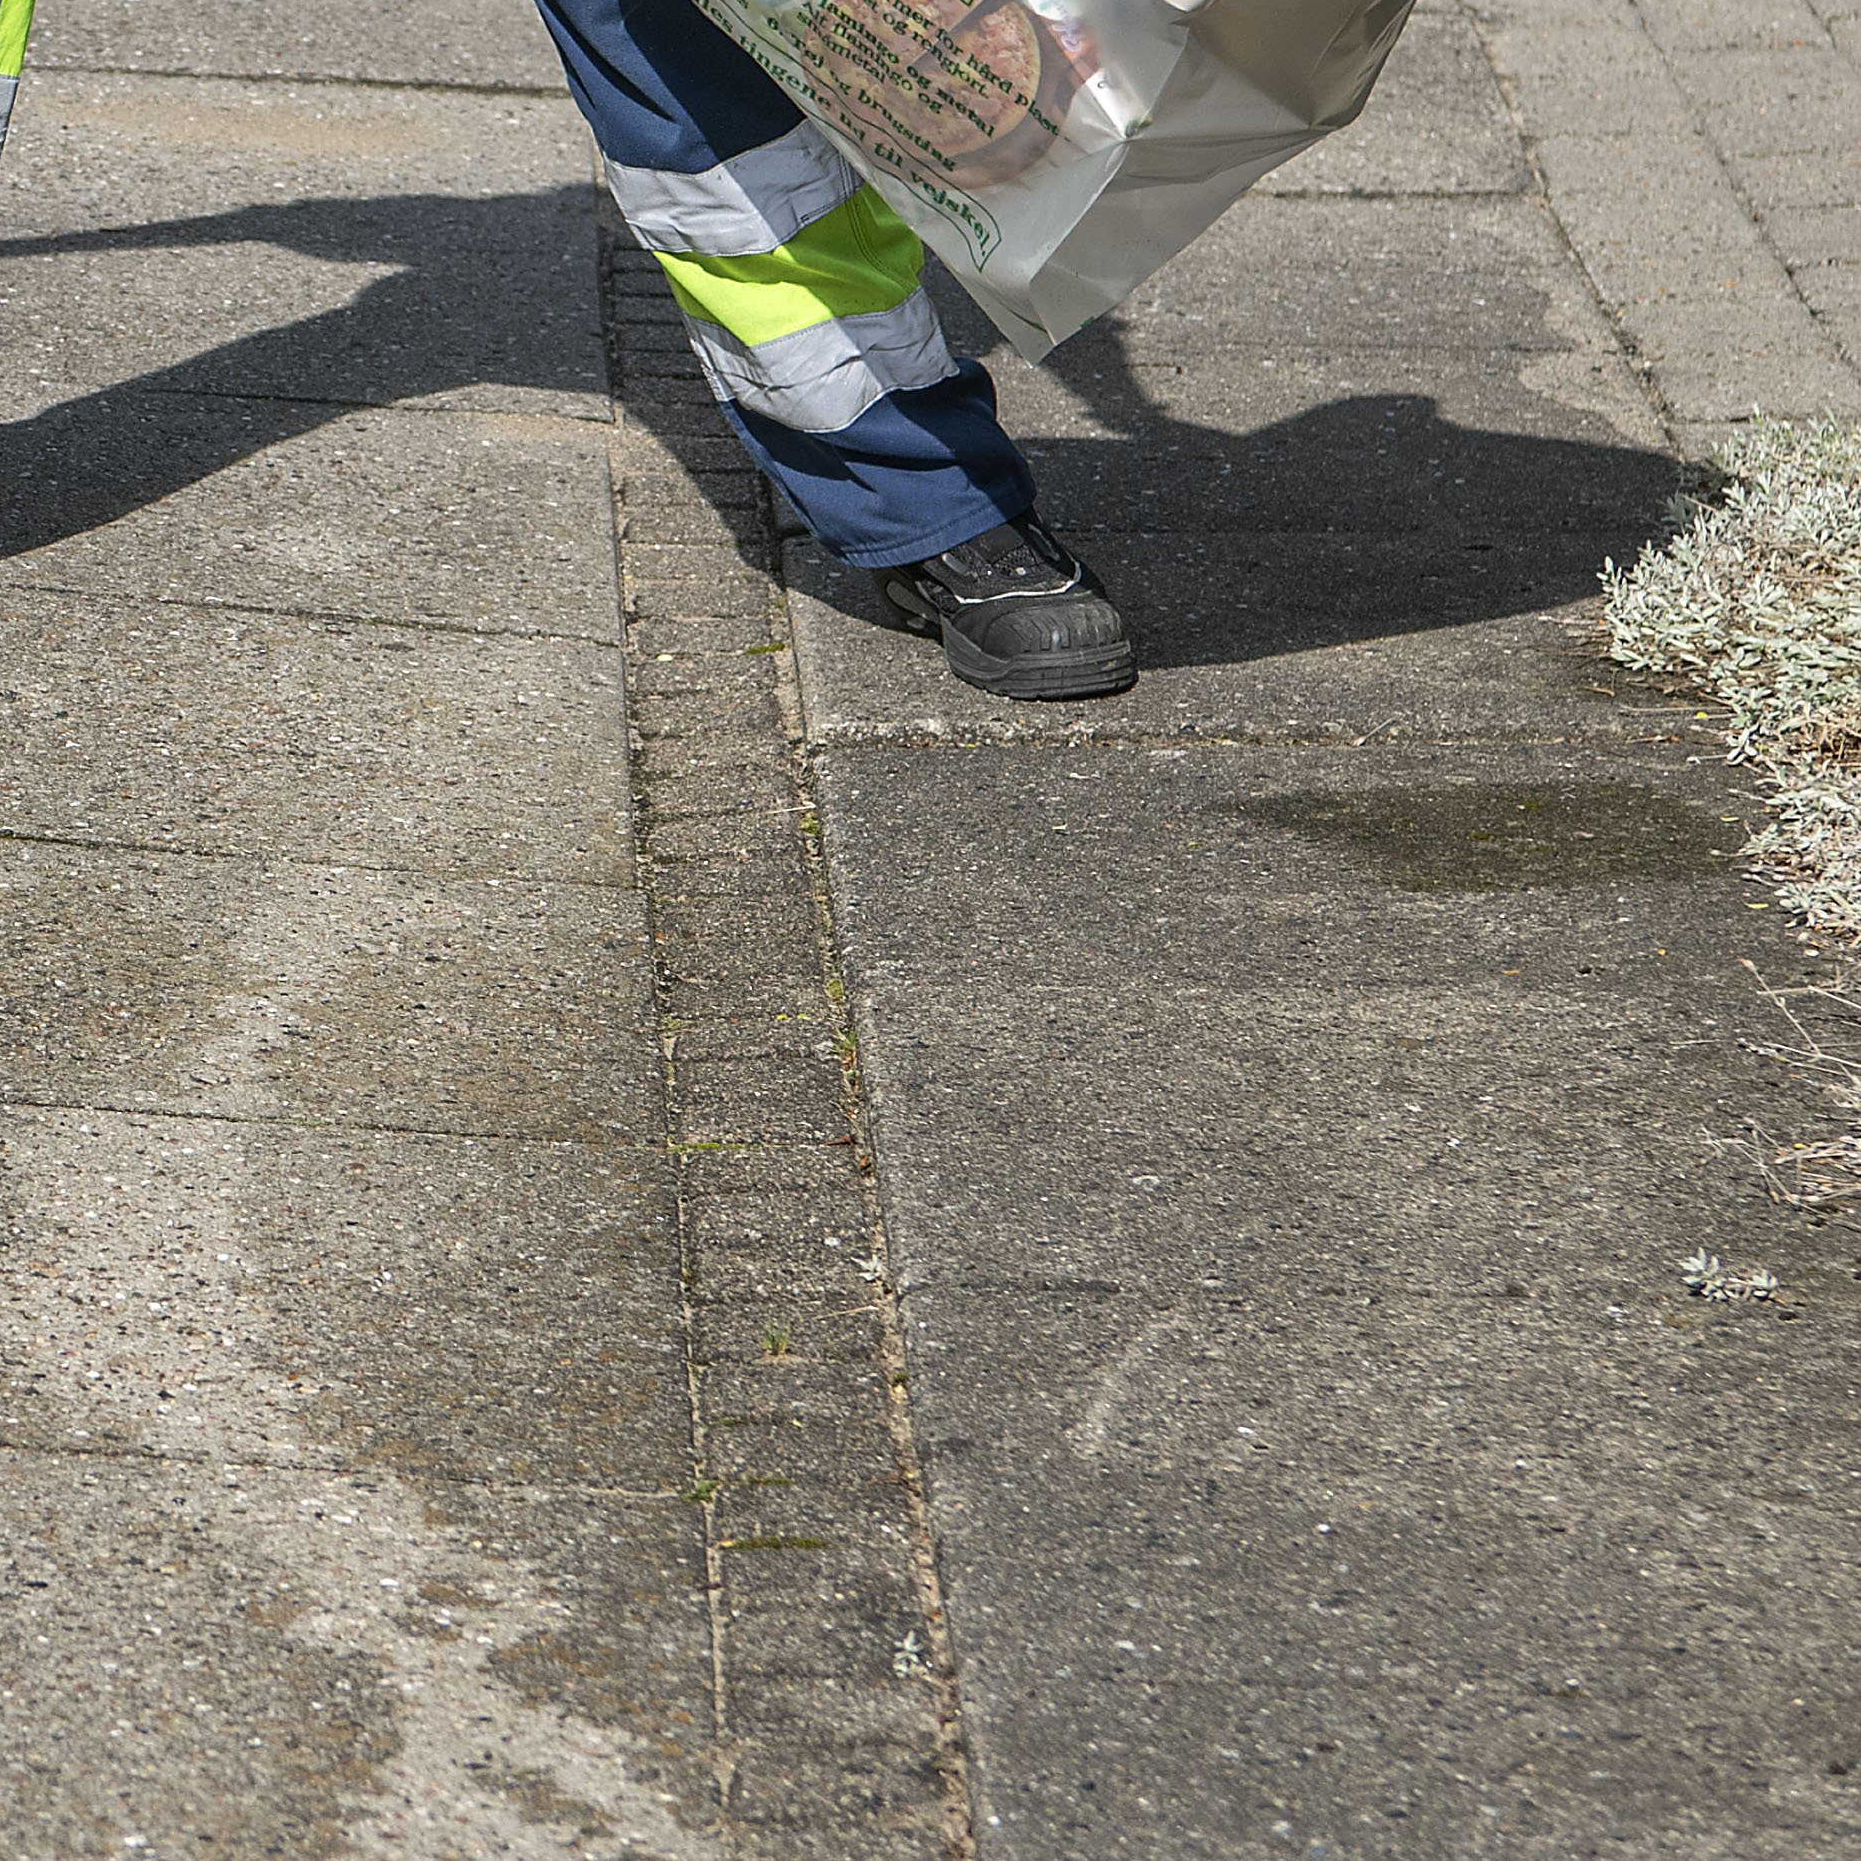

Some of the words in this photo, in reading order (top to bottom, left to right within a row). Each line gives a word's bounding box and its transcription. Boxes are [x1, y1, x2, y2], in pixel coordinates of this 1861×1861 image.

[831, 22, 915, 93] flamingo
[917, 92, 943, 116] og
[882, 11, 908, 36] og
[766, 17, 784, 36] 6.
[856, 90, 957, 173] brugsting
[906, 64, 932, 90] og
[935, 90, 995, 139] metal
[936, 26, 964, 56] for
[967, 53, 1013, 94] hård
[1014, 91, 1061, 136] plast
[739, 35, 830, 108] tingene
[874, 143, 903, 168] til
[910, 170, 993, 257] vejskel.
